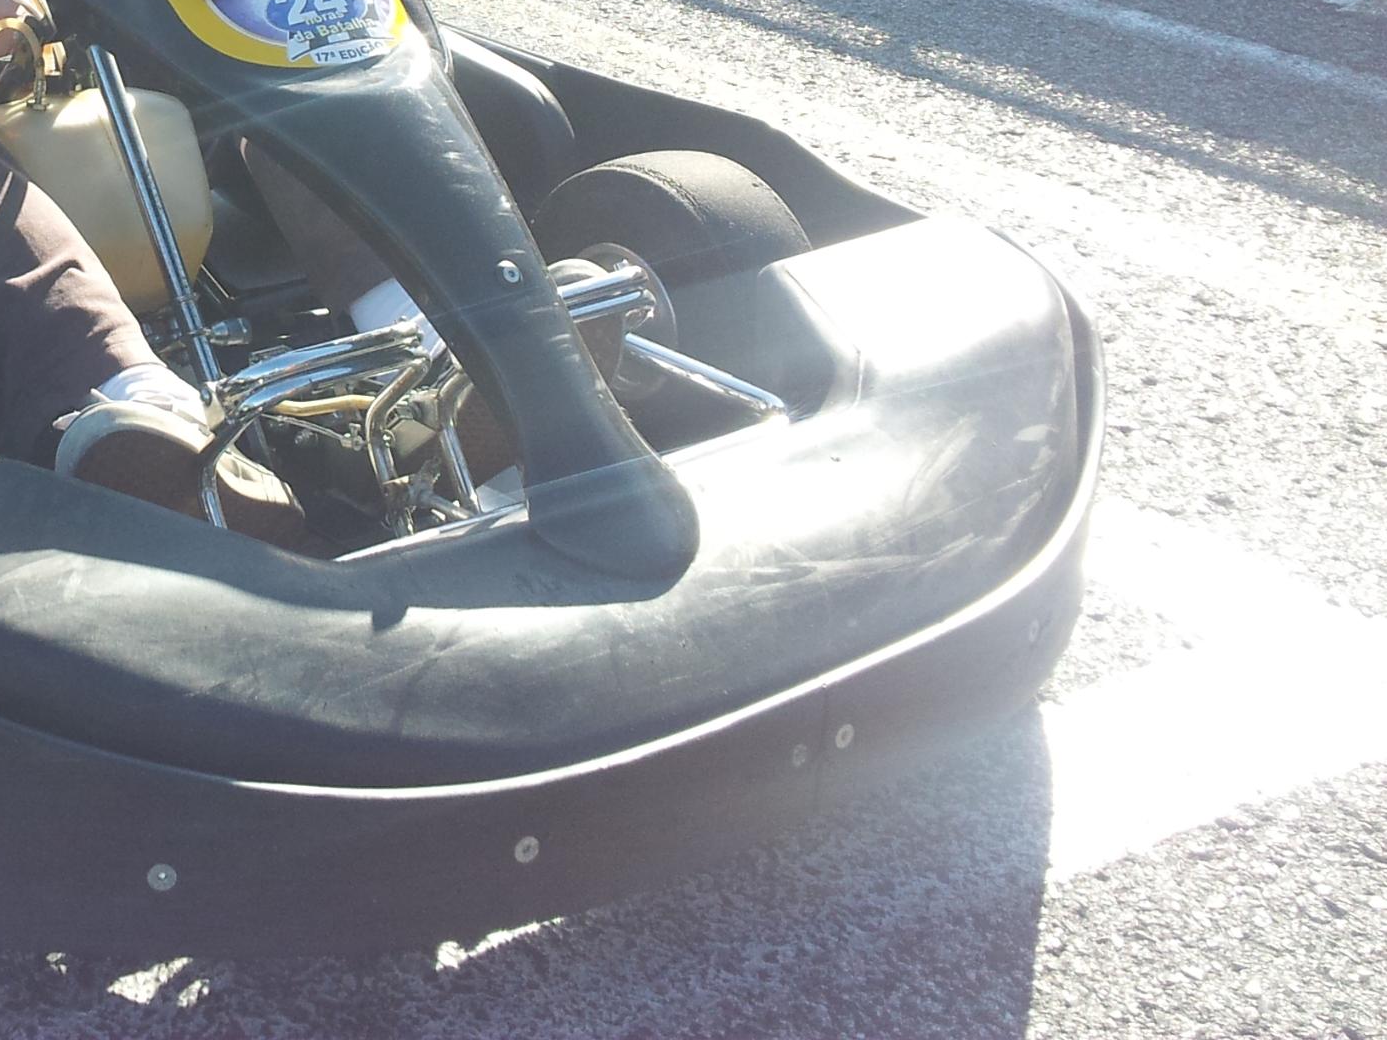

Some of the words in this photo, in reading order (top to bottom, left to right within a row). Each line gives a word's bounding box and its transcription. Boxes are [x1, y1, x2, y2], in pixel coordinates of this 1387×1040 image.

[304, 10, 345, 27] horas
[293, 27, 315, 44] da
[317, 16, 375, 37] Batalha
